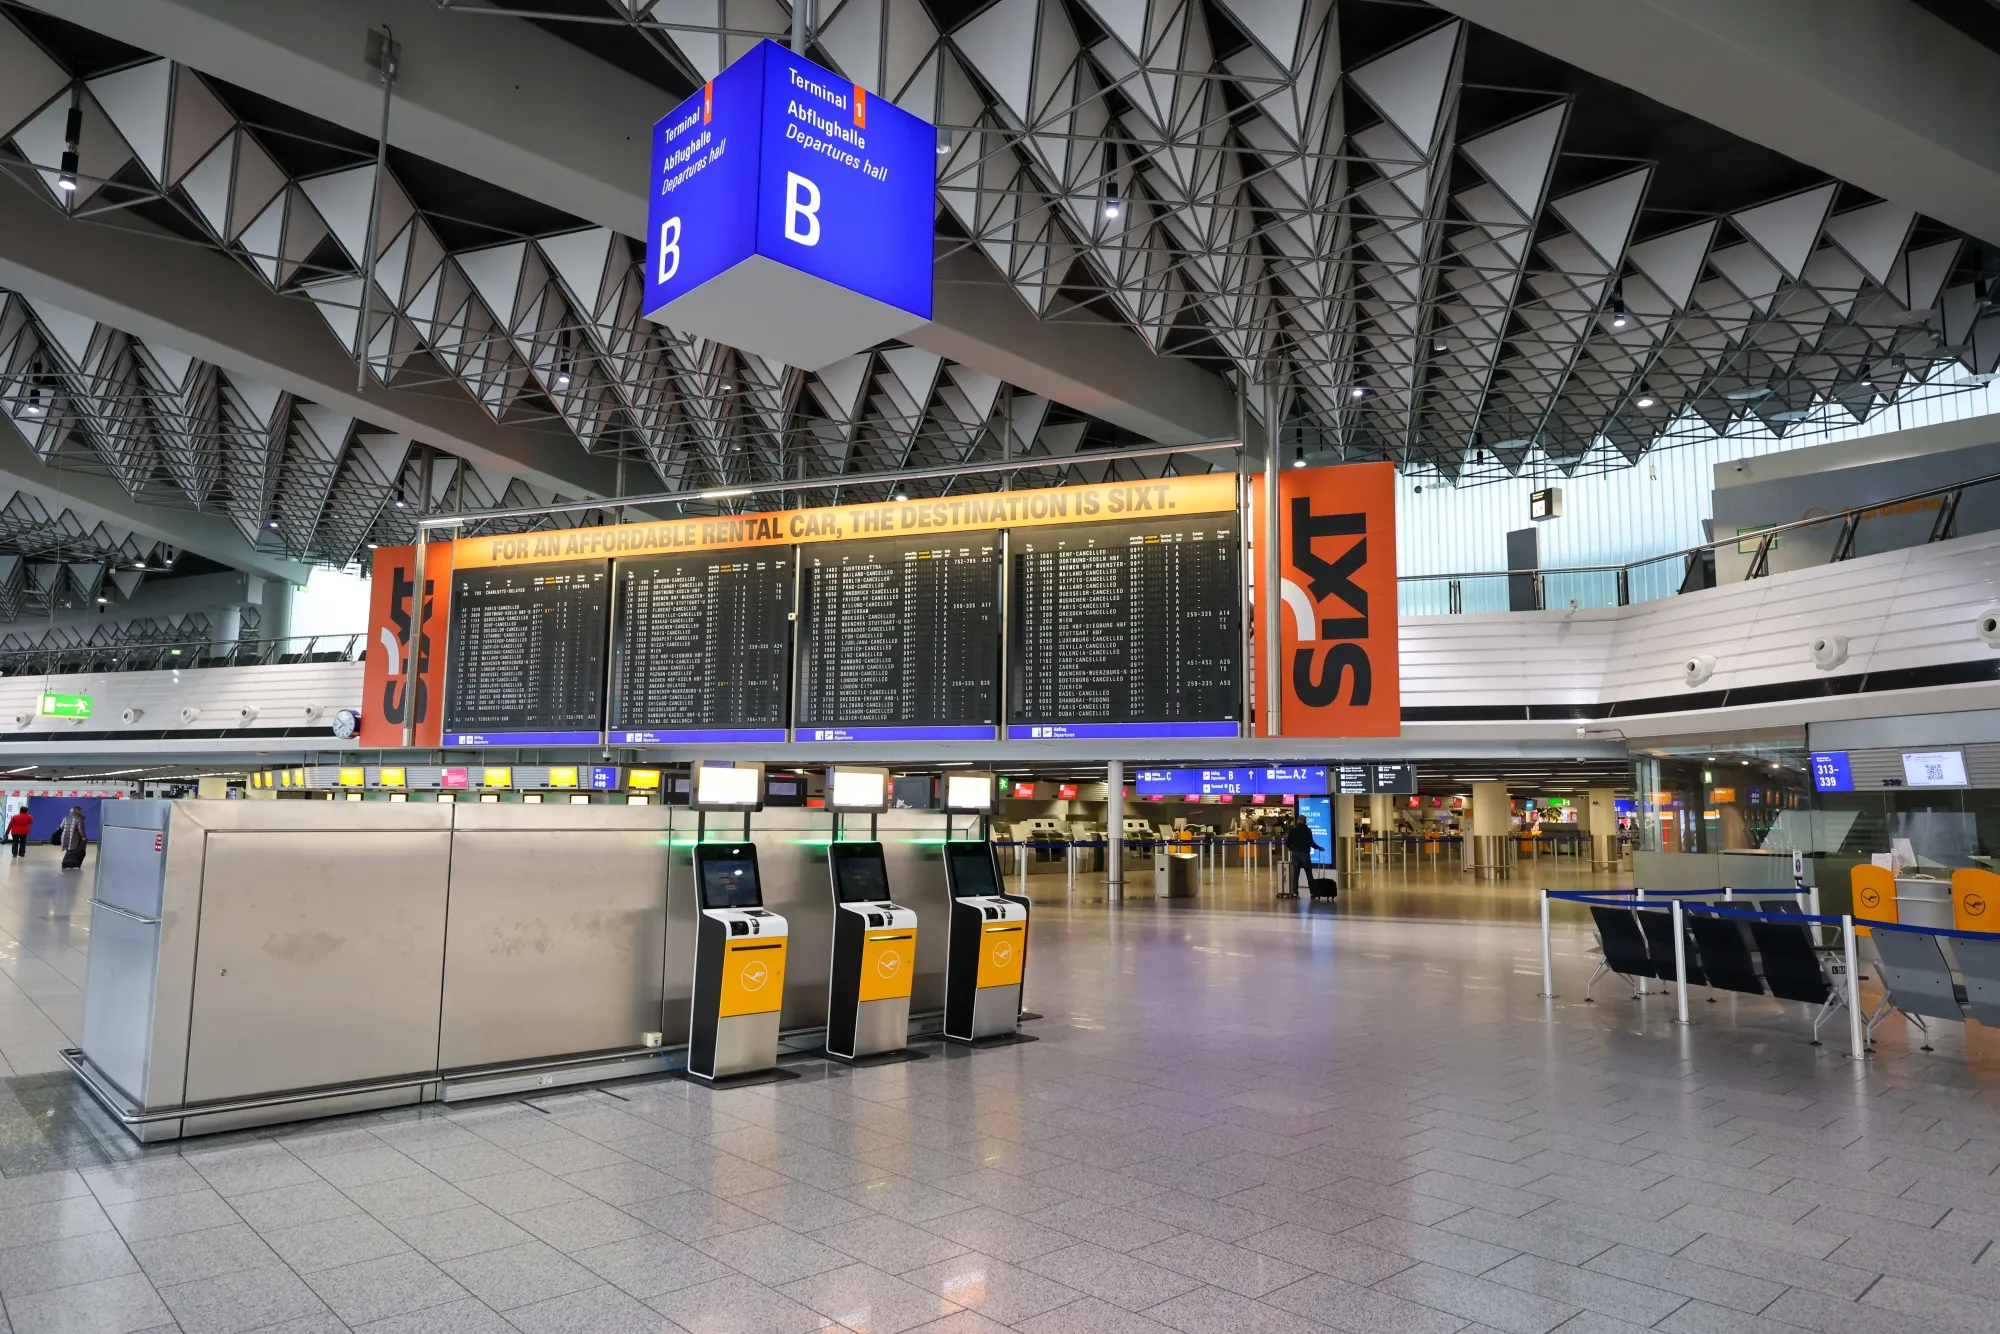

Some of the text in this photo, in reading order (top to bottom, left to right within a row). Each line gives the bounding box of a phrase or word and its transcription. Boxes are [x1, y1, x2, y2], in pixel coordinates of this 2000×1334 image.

[789, 68, 862, 118] Terminal 1
[666, 99, 710, 144] Terminal 1
[788, 100, 866, 150] Abflughalle
[662, 138, 726, 196] Departures hall
[664, 130, 712, 174] Abflughalle
[786, 124, 888, 182] Departures hall
[784, 170, 821, 247] B
[658, 216, 682, 286] B
[492, 484, 1176, 561] FOR AN AFFORDABLE RENTAL CAR, THE DESTINATION IS SIXT.
[1292, 496, 1372, 708] SIXT
[383, 566, 434, 725] SIXT
[1166, 772, 1172, 781] C
[1228, 770, 1234, 780] B
[1228, 783, 1240, 794] D,E
[1293, 769, 1306, 780] A,Z
[1817, 764, 1838, 775] 313-
[1820, 777, 1836, 786] 339
